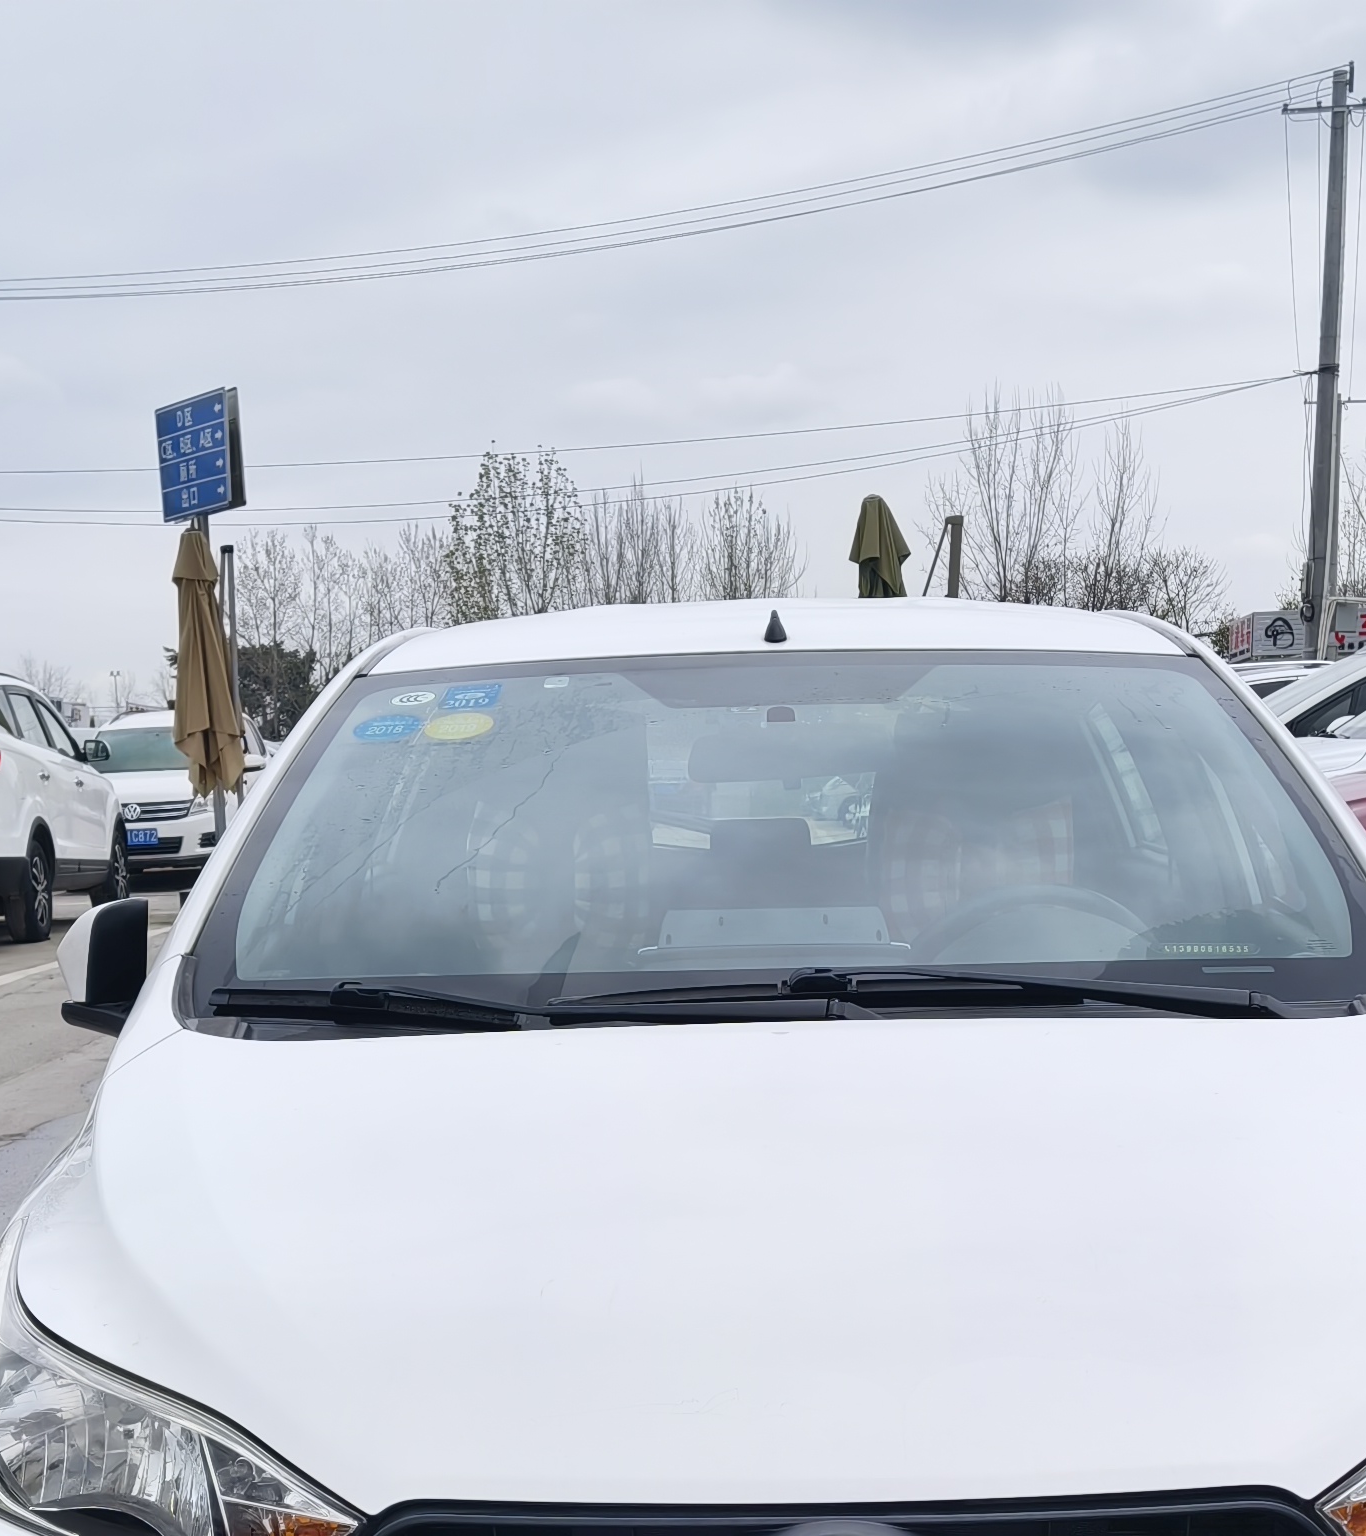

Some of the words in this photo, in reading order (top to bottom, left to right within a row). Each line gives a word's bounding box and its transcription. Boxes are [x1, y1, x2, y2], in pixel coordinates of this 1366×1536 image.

[176, 406, 193, 427] D区
[180, 486, 198, 508] 出口
[442, 697, 490, 709] 2019
[366, 725, 404, 735] 2018
